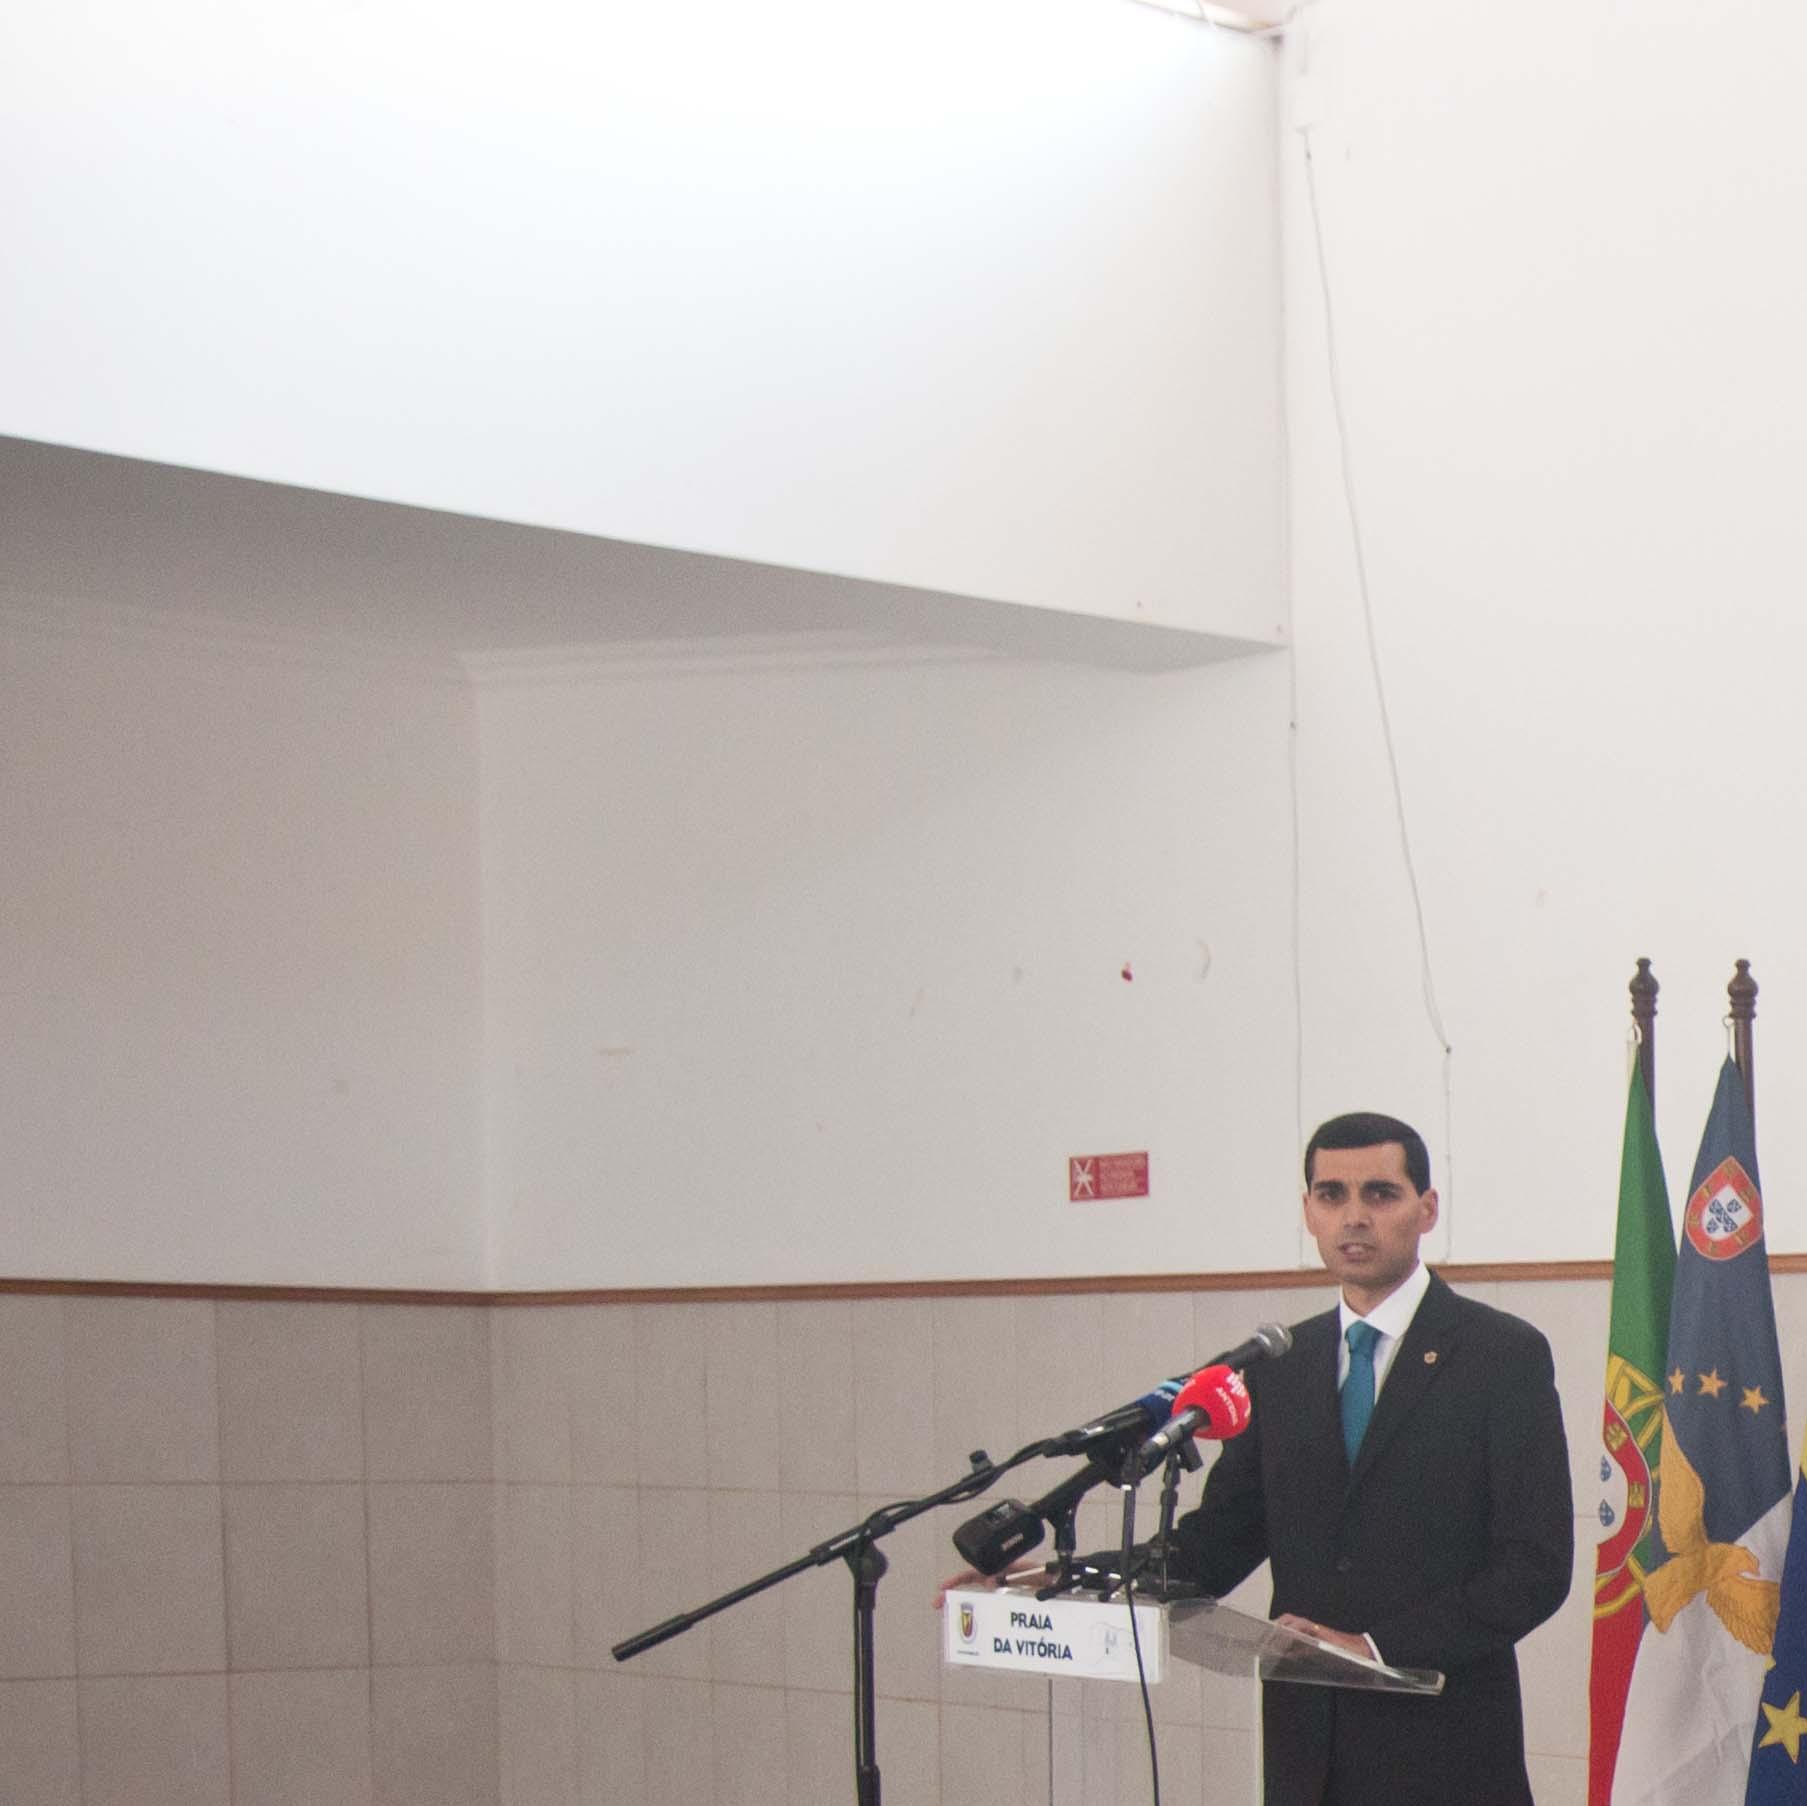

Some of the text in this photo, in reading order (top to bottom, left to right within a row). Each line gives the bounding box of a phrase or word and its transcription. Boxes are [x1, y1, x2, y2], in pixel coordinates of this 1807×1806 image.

[1010, 1611, 1053, 1631] PRAIA
[993, 1636, 1073, 1661] DA VITÓRIA
